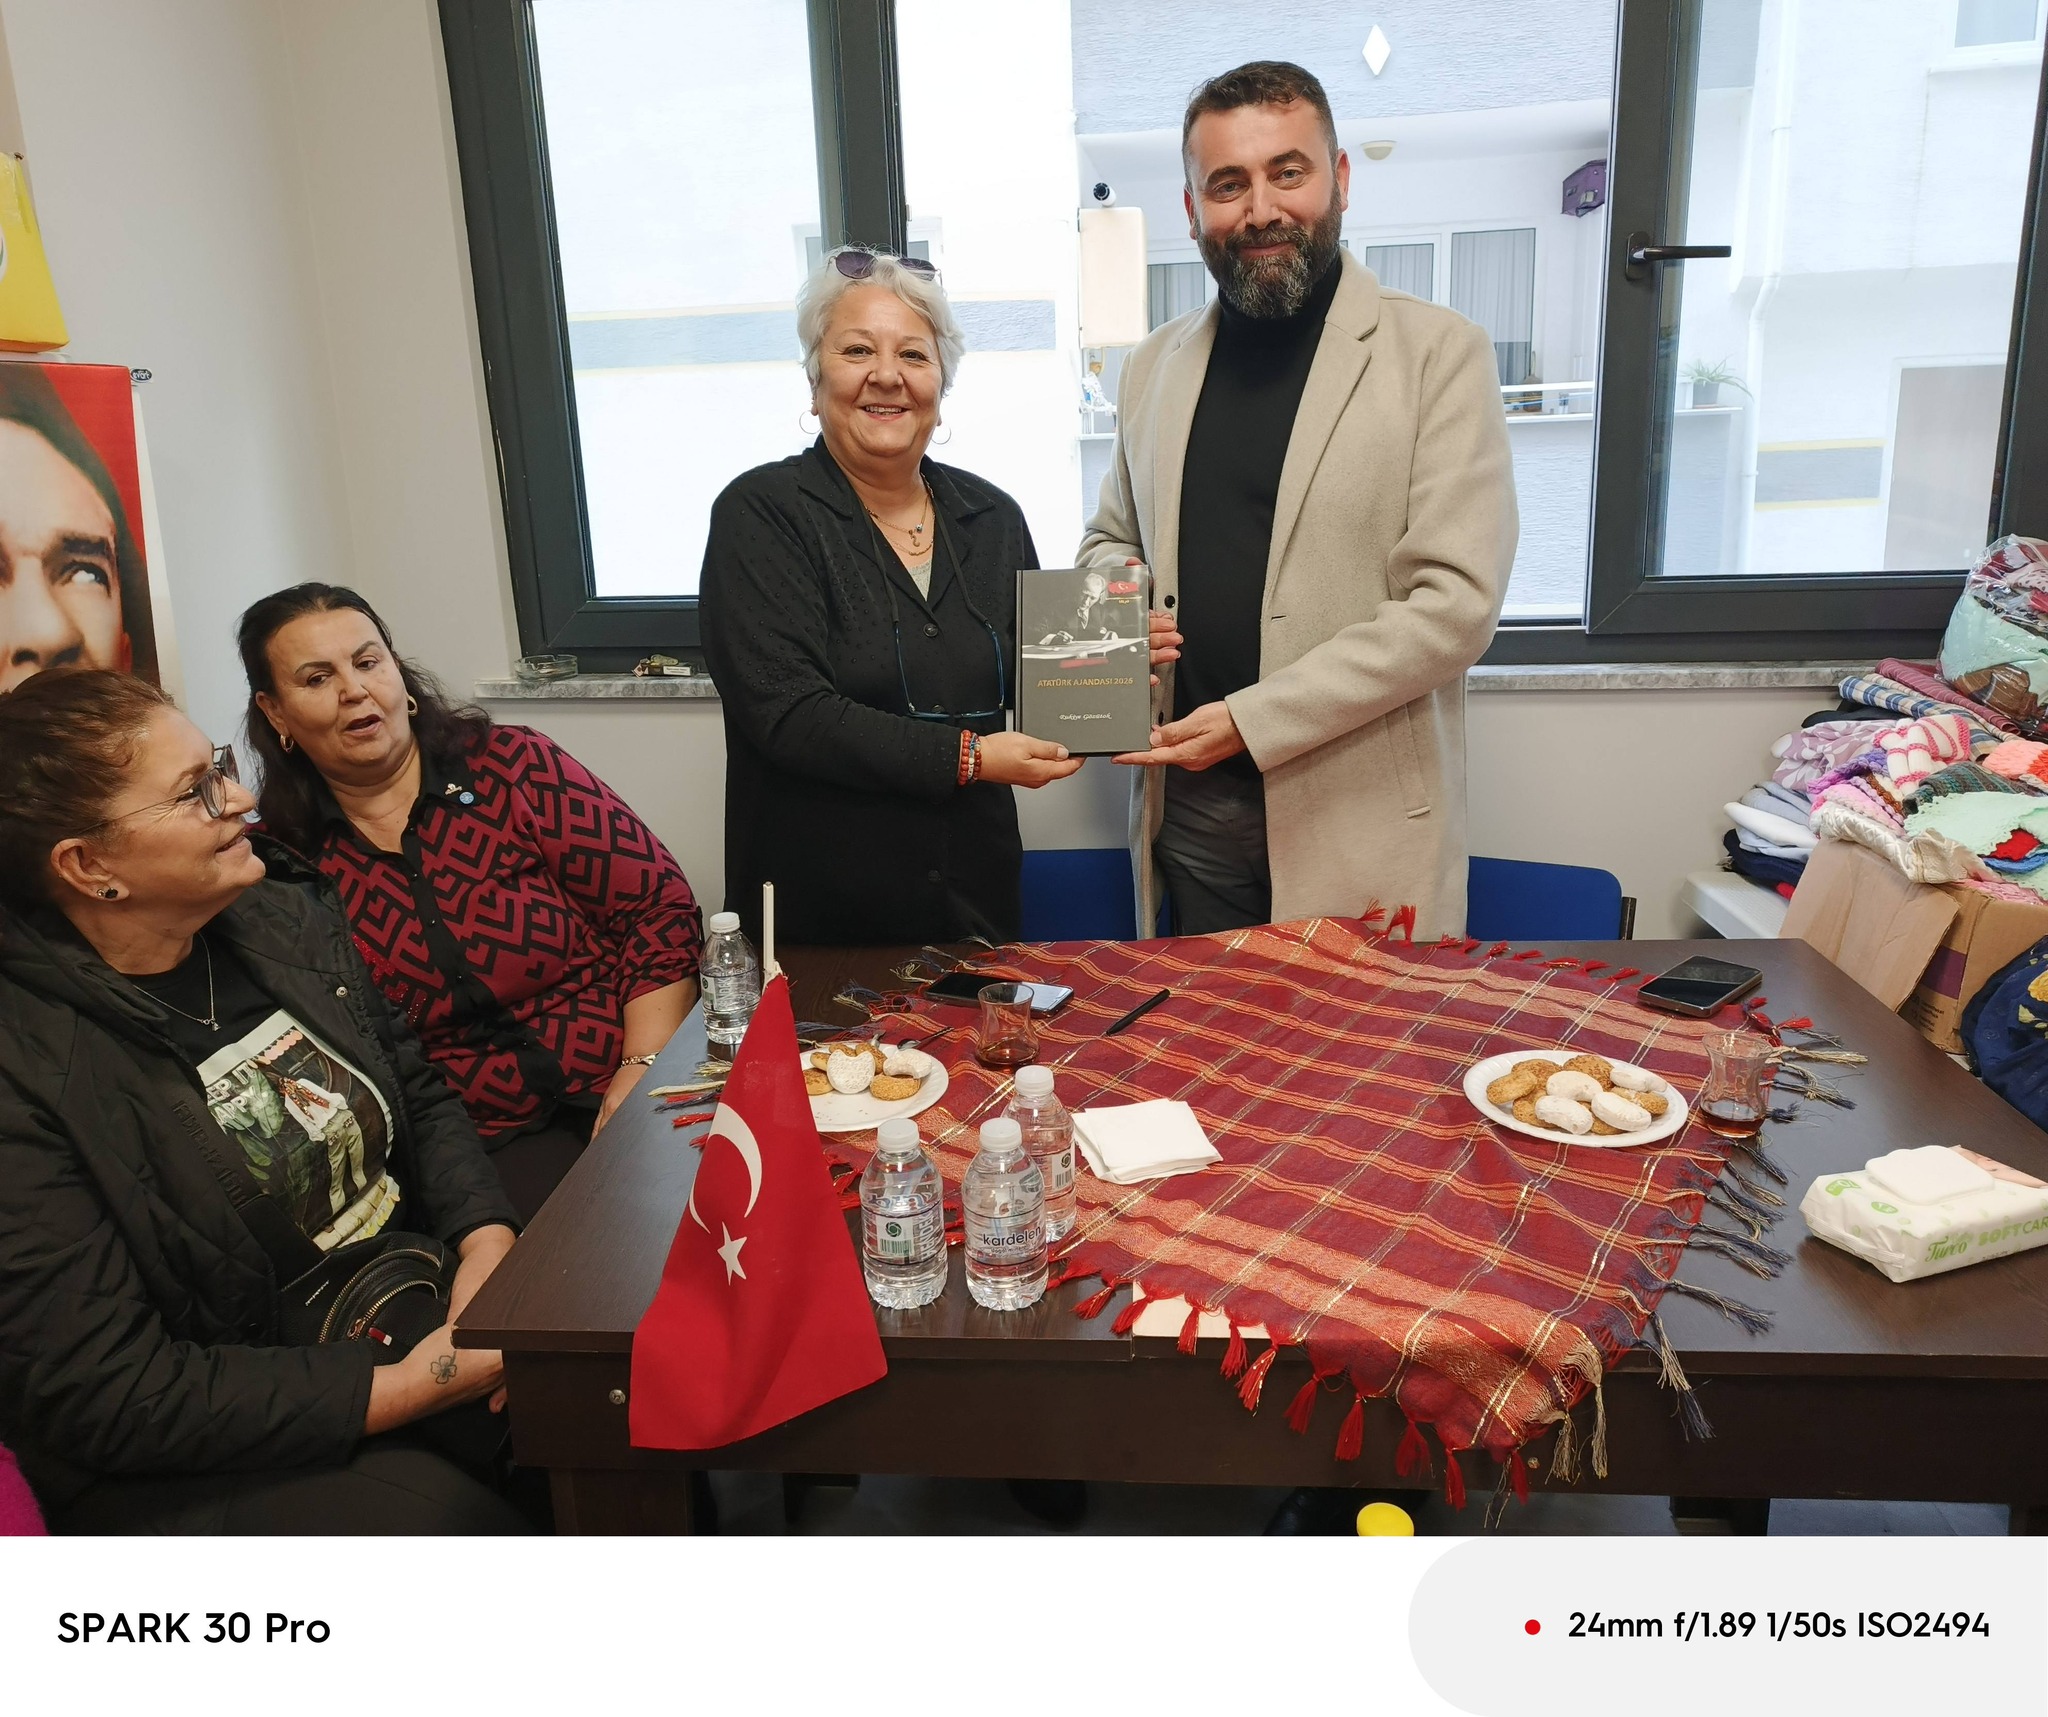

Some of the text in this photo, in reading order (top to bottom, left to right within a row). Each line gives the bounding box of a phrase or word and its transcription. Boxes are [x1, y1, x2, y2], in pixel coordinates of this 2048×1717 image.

[1037, 678, 1072, 688] ATATÜRK
[1073, 678, 1112, 687] AJANDASI
[983, 1226, 1041, 1247] kardelen
